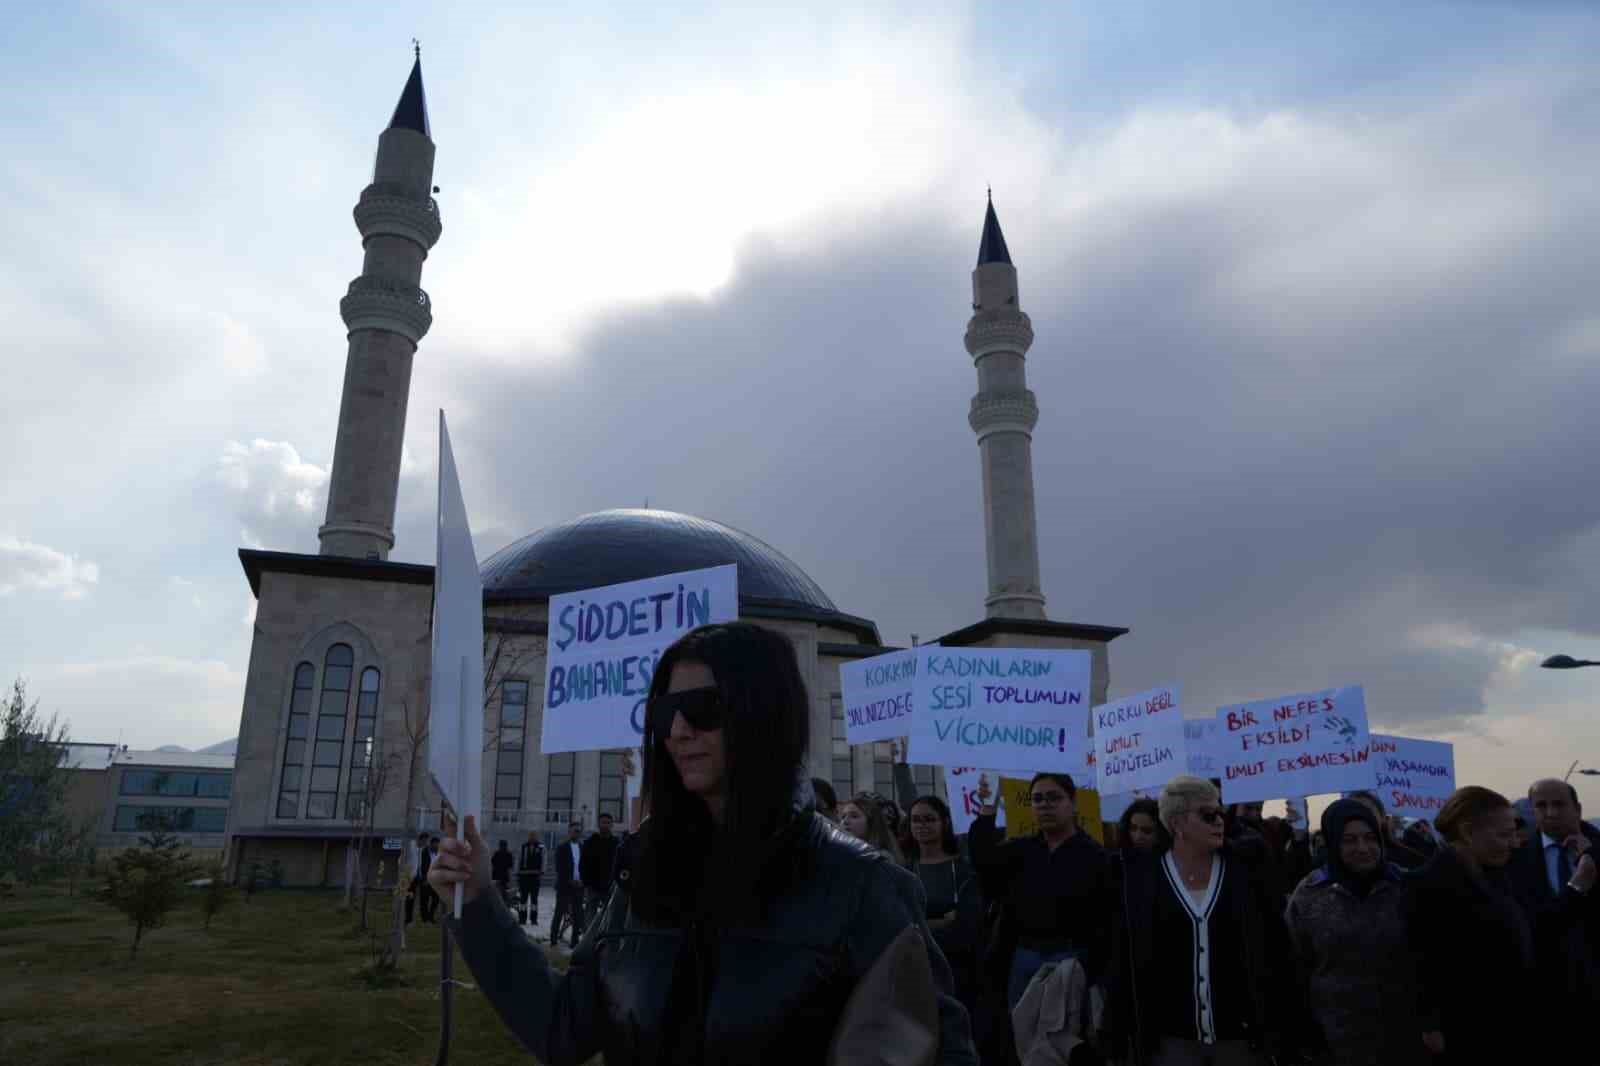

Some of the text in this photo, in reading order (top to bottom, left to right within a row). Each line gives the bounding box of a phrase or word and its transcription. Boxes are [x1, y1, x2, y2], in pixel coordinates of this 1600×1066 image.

[556, 584, 709, 650] ŞİDDETİN
[928, 656, 1052, 677] KADINLARIN
[928, 681, 1081, 709] SESİ TOPLUMUN
[1099, 704, 1142, 728] KORKU
[1227, 708, 1259, 732] BİR
[1273, 697, 1335, 722] NEFES
[1105, 733, 1141, 754] UMUT
[1226, 761, 1265, 780] UMUT
